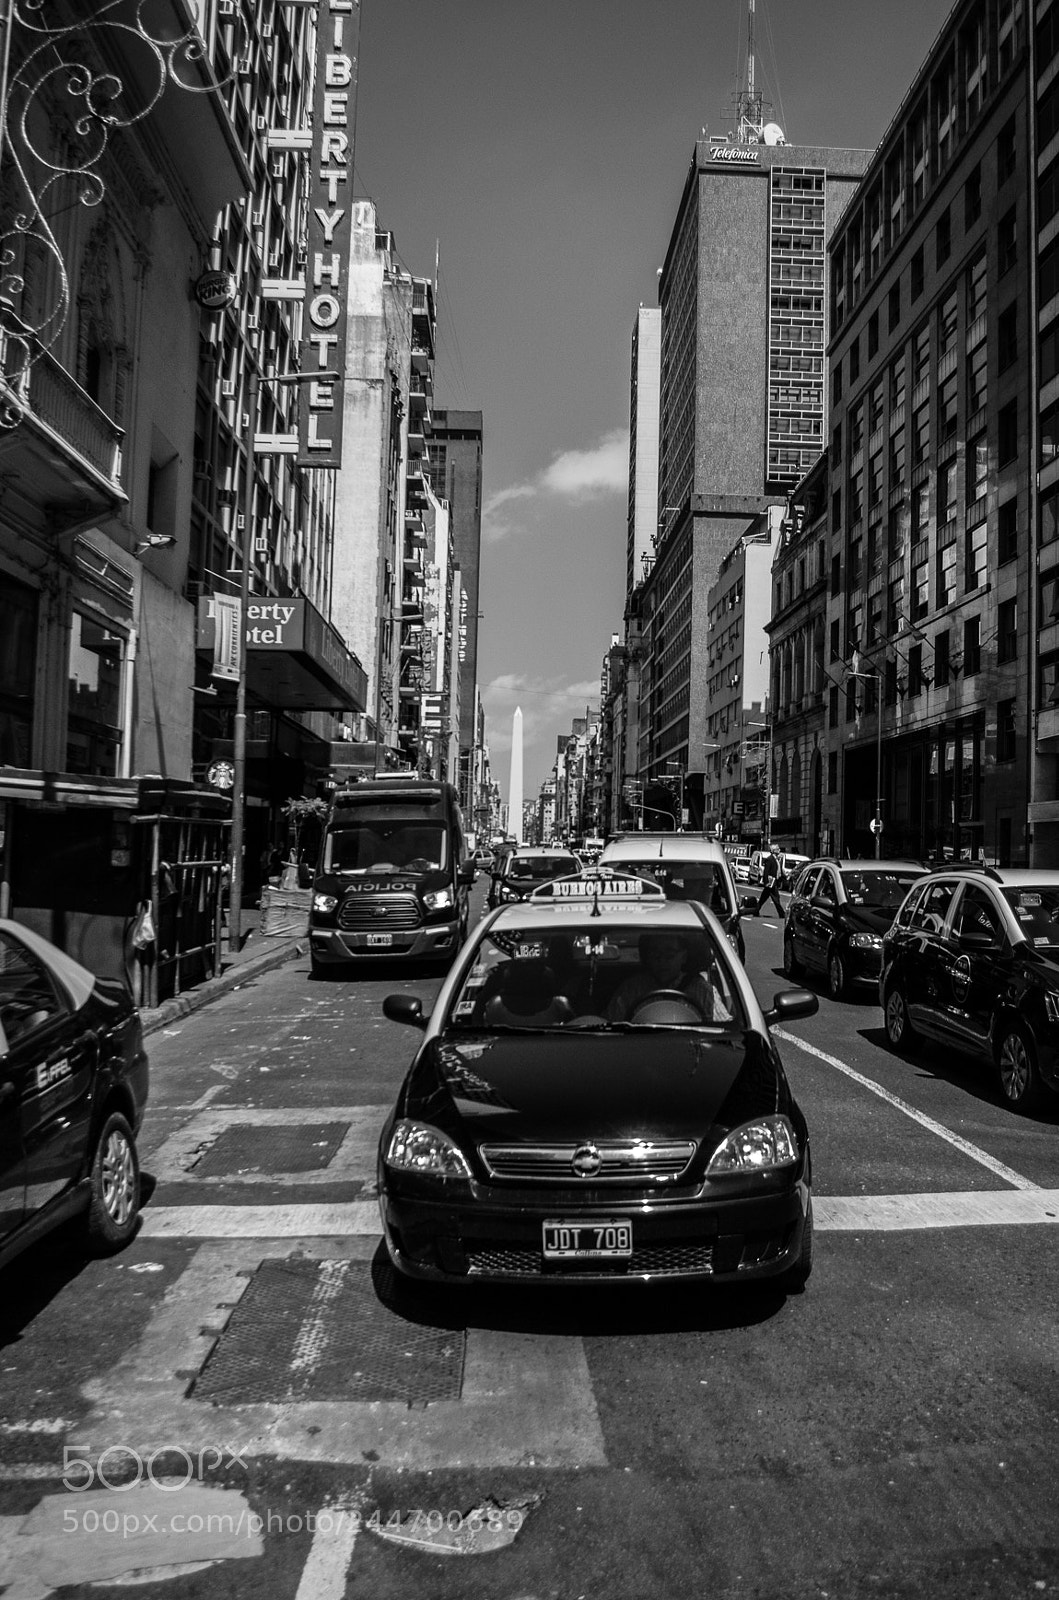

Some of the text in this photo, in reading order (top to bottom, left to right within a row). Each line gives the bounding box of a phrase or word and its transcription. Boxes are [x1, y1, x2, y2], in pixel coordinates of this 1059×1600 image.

[307, 253, 341, 448] HOTEL
[603, 881, 642, 895] AIRES
[547, 1228, 628, 1250] JDT 708
